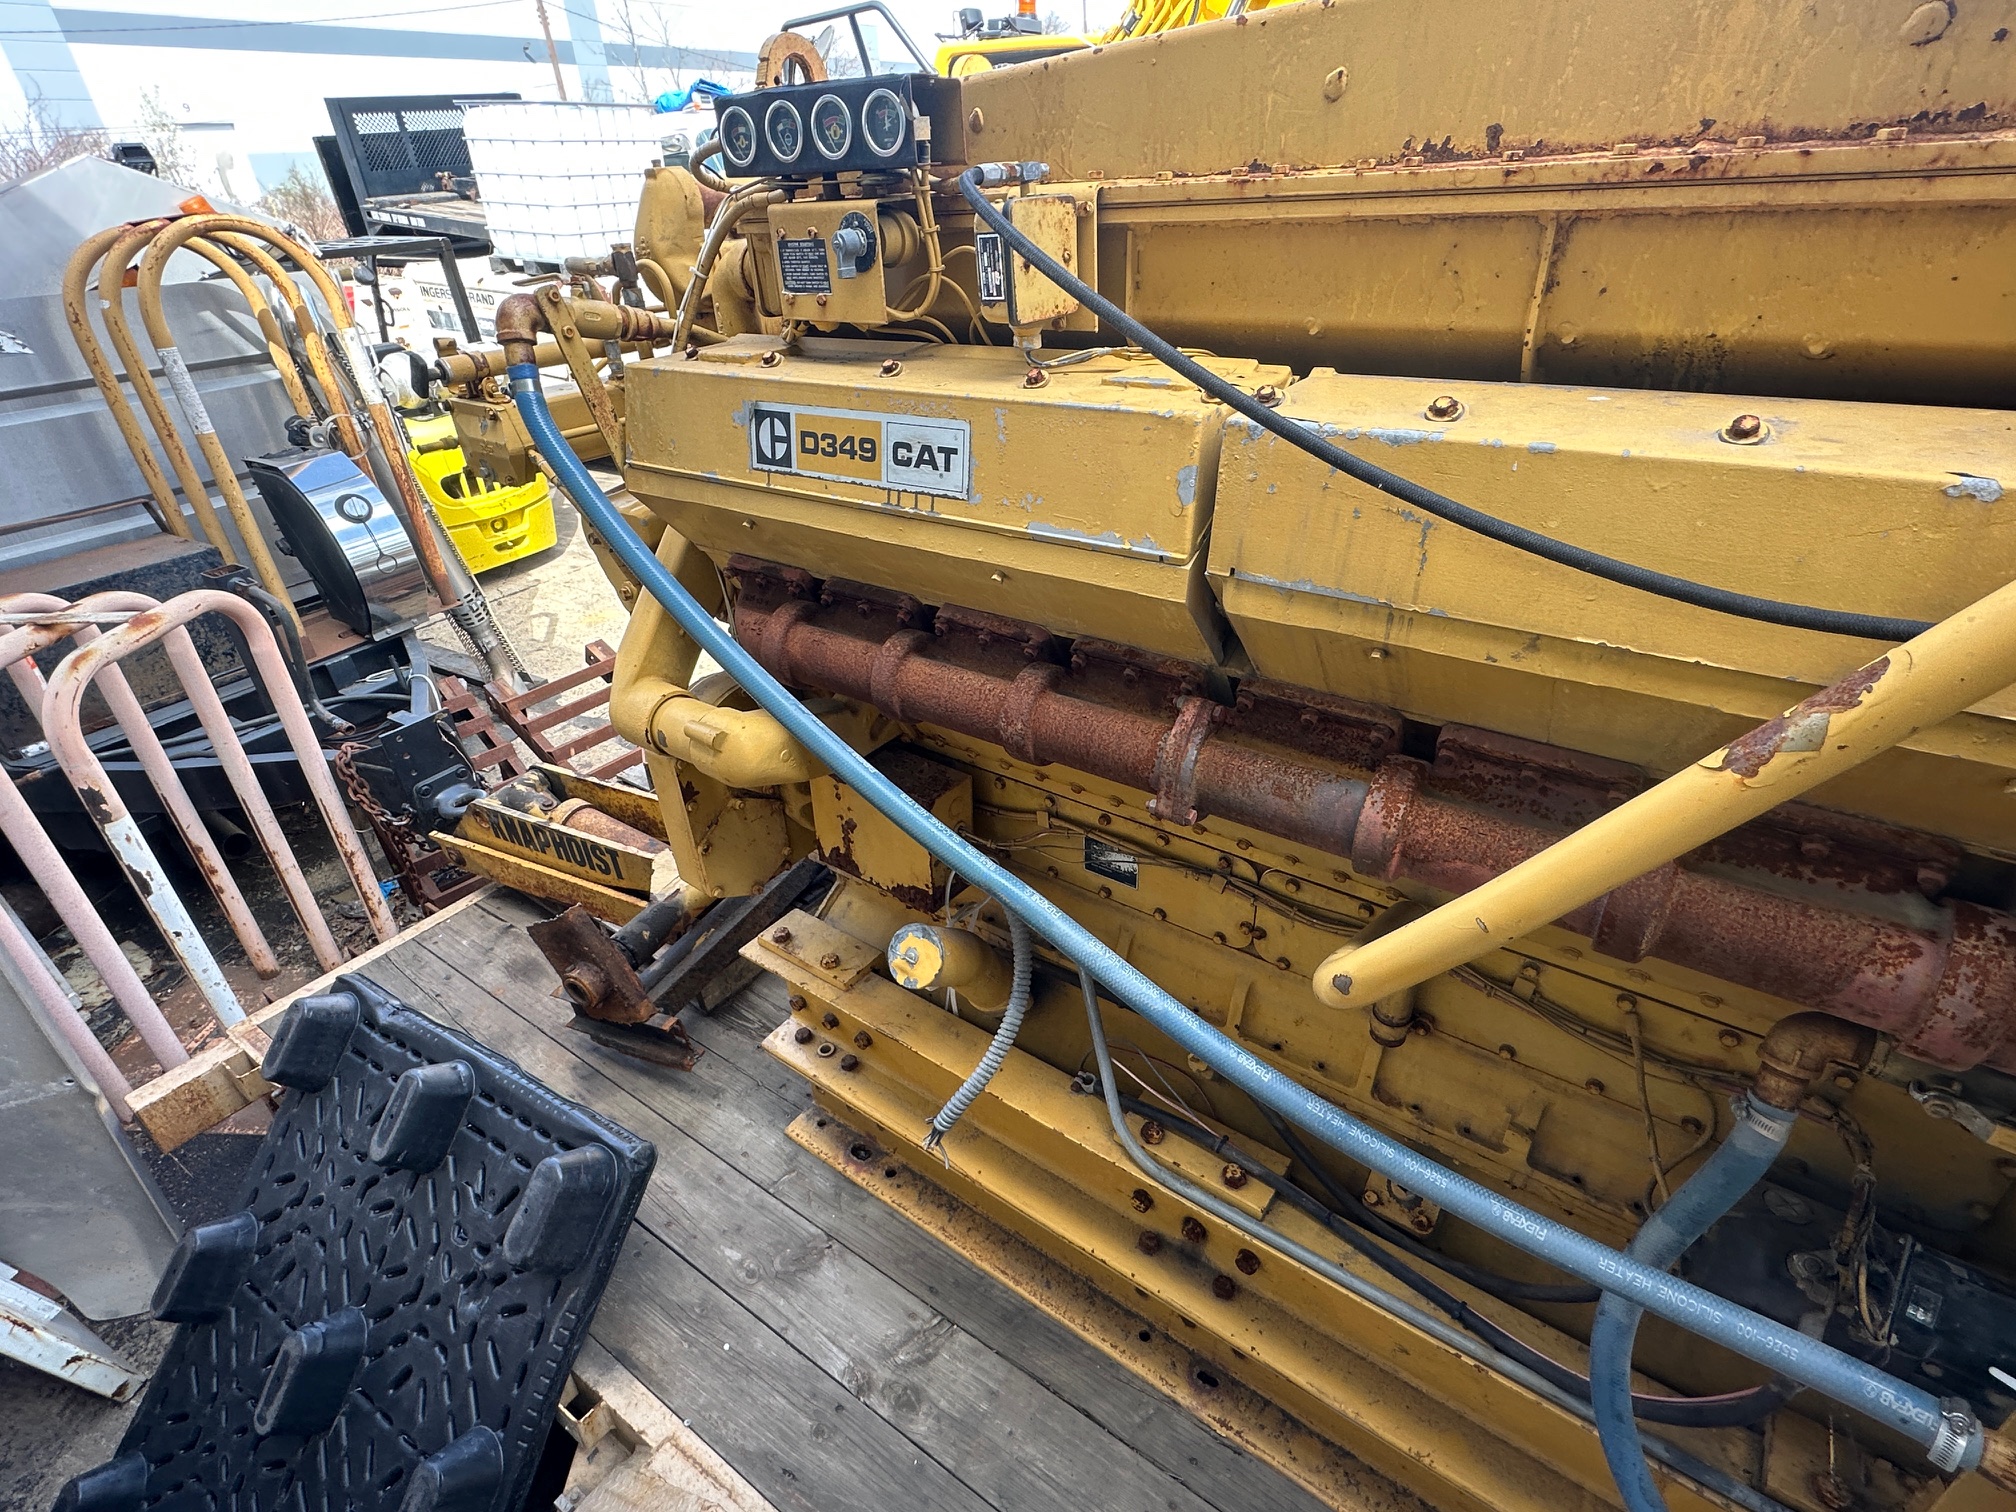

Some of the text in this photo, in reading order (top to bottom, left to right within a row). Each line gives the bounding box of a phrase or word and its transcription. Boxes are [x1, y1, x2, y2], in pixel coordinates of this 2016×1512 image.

[419, 286, 495, 306] INGERSRAND
[800, 430, 958, 473] D349 CAT
[899, 791, 928, 816] HEATER
[1030, 893, 1061, 919] FLEXFAB
[1087, 938, 1122, 967] HEATER
[1122, 965, 1160, 998] SILICONE
[1236, 1053, 1272, 1081] FLEXFAB
[1304, 1097, 1448, 1188] 5526-100 SILICONE HEATER
[1500, 1209, 1548, 1240] FLEXFAB
[1596, 1256, 1799, 1360] 5526-100 SILICONE HEATER
